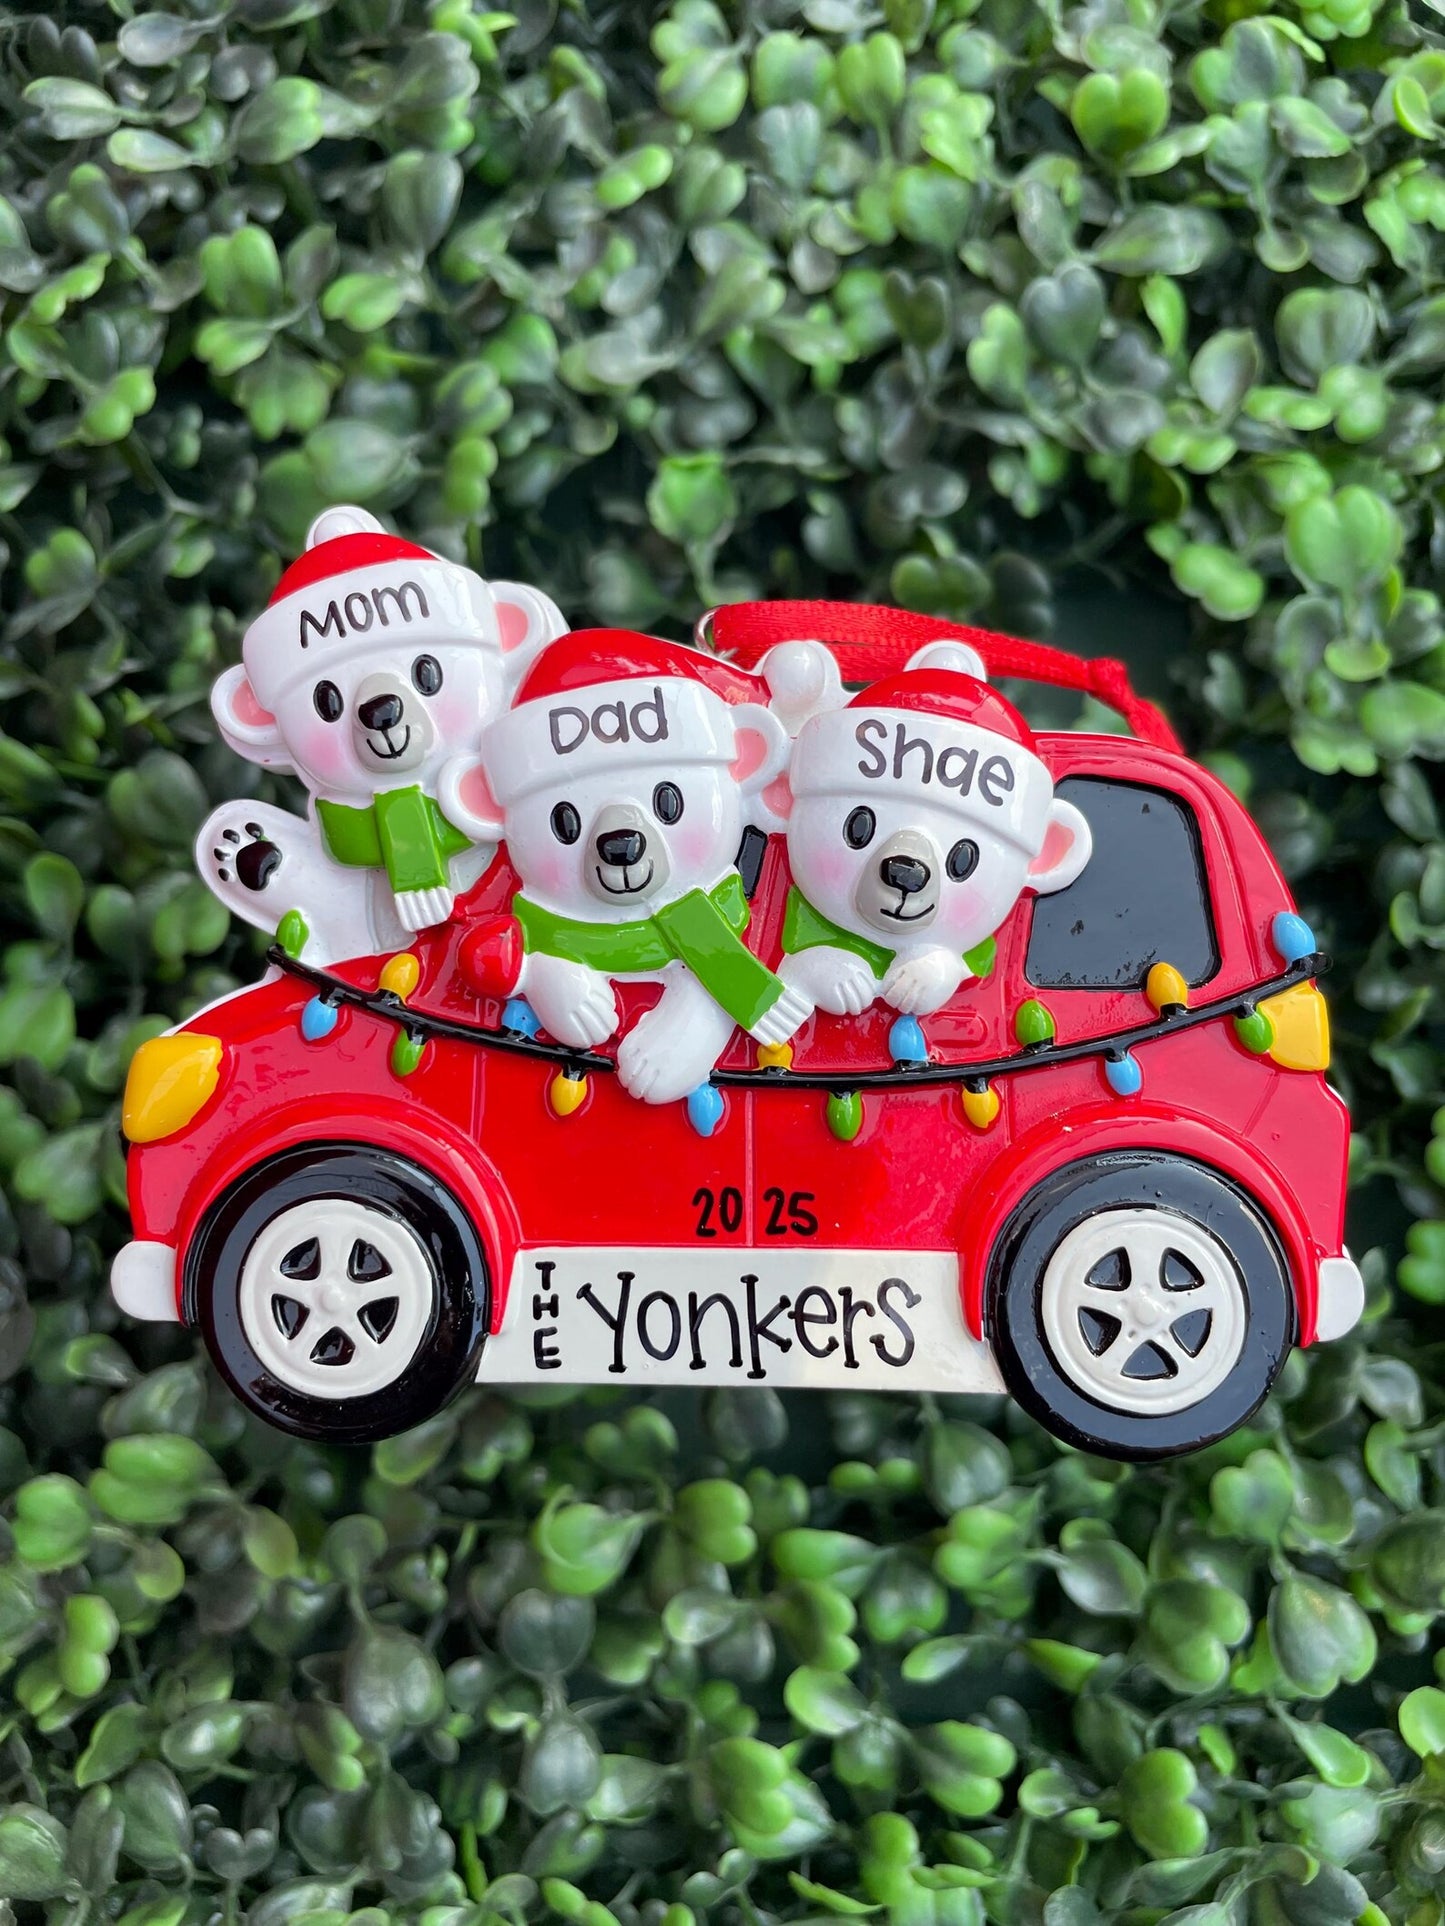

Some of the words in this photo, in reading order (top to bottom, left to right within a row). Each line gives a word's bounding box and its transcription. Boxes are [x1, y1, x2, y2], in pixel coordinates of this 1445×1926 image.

[299, 580, 430, 649] Mom
[548, 685, 669, 756] Dad
[855, 718, 1016, 807] Shae
[532, 1260, 563, 1370] THE
[576, 1271, 922, 1380] Yonkers
